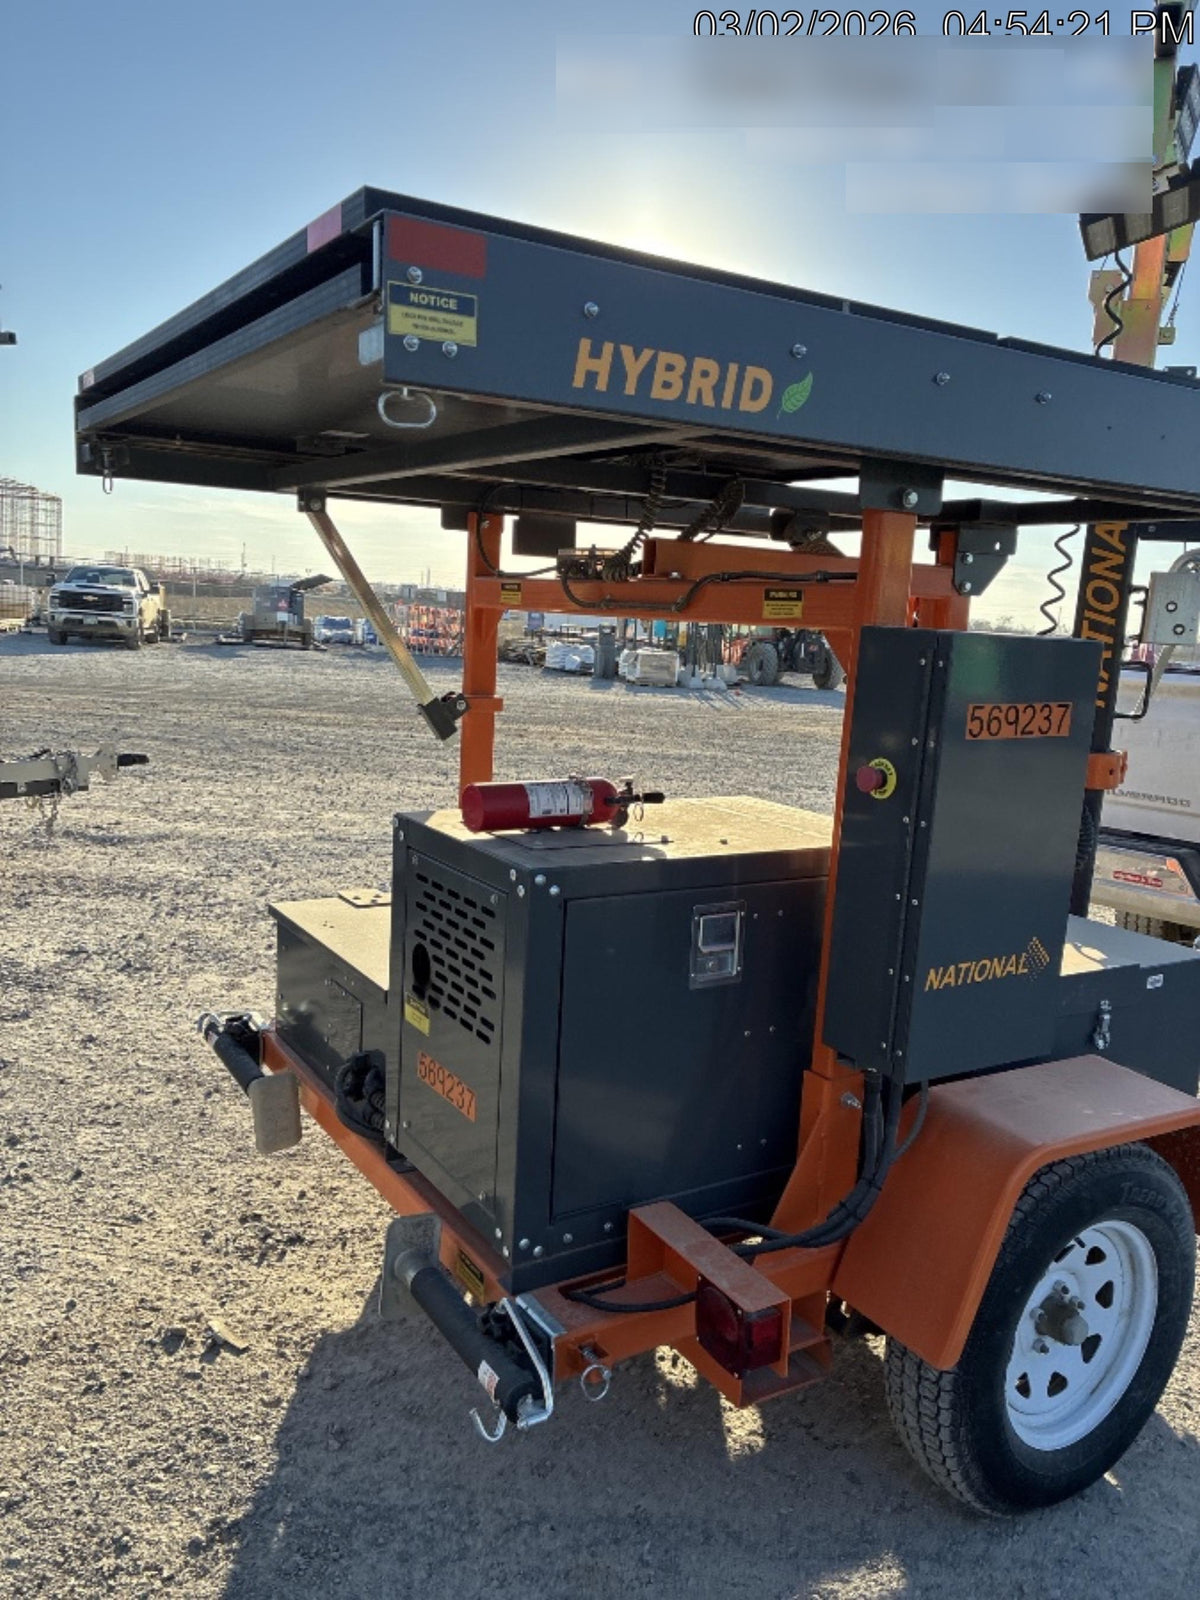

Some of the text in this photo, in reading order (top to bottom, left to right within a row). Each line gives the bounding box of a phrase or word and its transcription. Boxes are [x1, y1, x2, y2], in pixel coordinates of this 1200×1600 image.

[410, 292, 458, 310] NOTICE
[572, 337, 774, 413] HYBRID
[968, 703, 1070, 738] 569237
[924, 952, 1029, 992] NATIONAL
